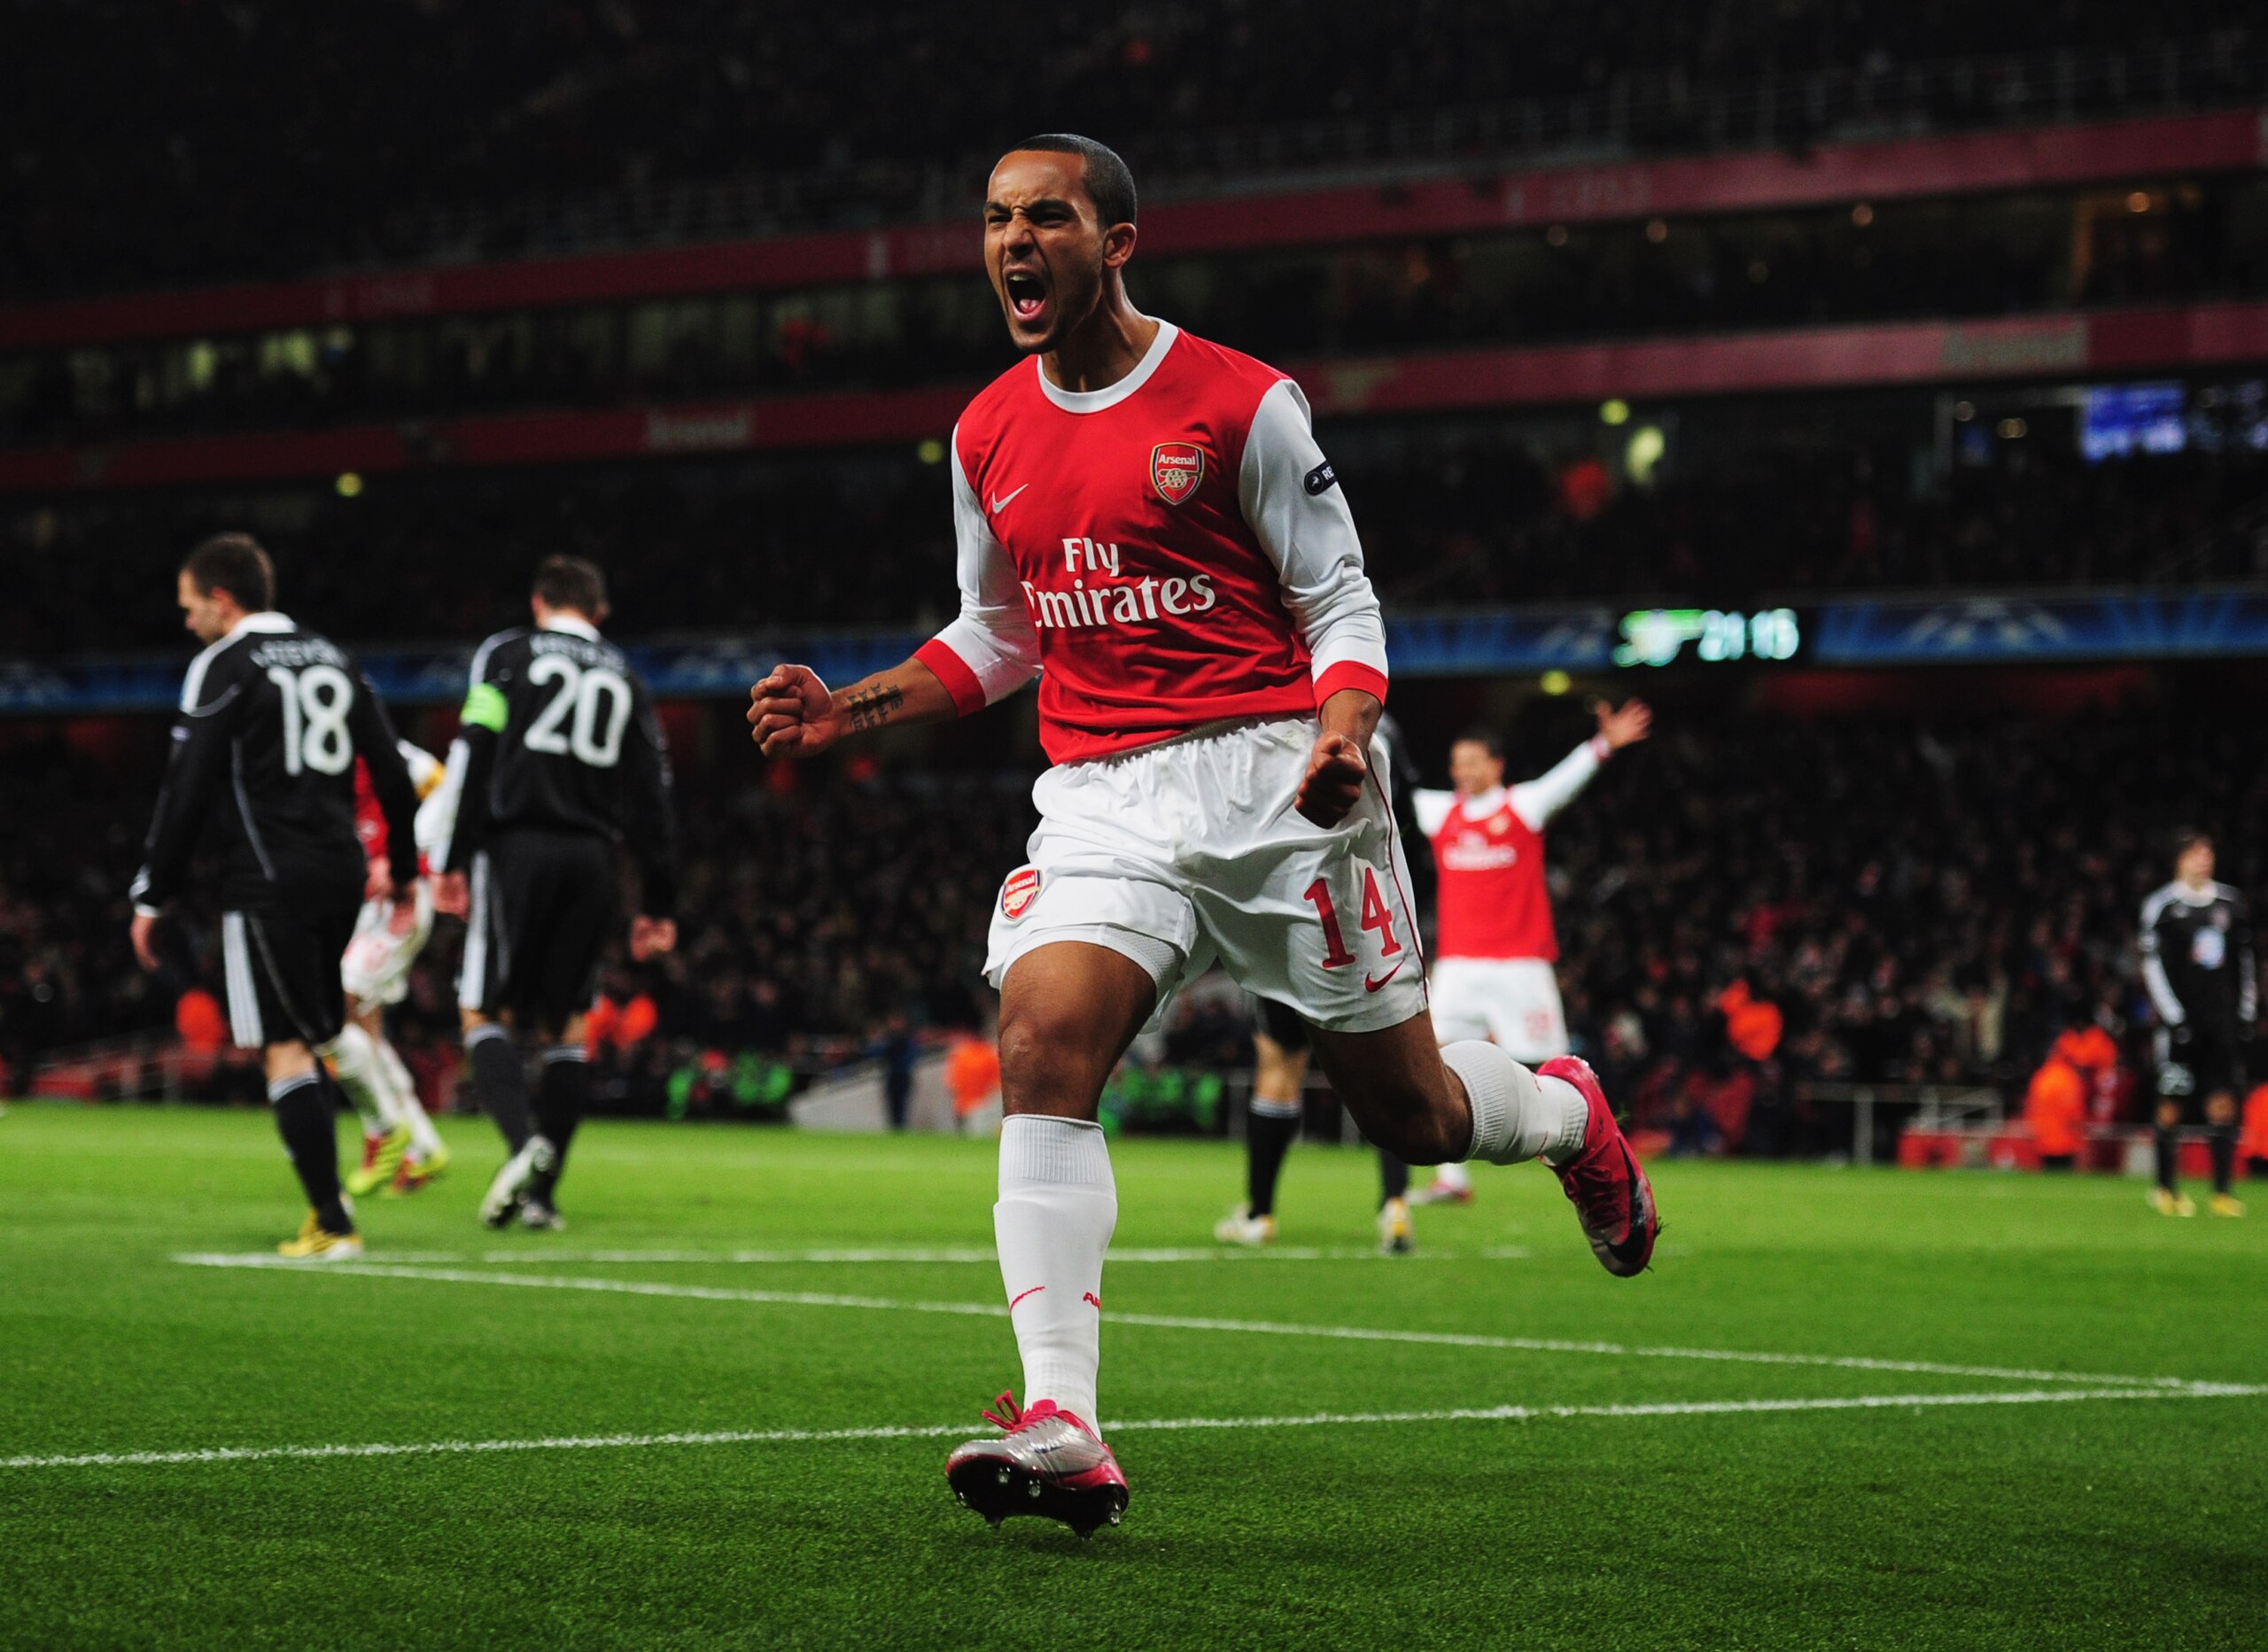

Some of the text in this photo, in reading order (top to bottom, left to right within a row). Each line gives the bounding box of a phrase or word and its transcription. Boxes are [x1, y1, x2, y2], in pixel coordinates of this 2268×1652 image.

[1159, 454, 1196, 466] Arsenal
[1062, 537, 1120, 578] Fly
[268, 665, 354, 777] 18
[524, 652, 633, 767] 20
[1303, 866, 1402, 969] 14
